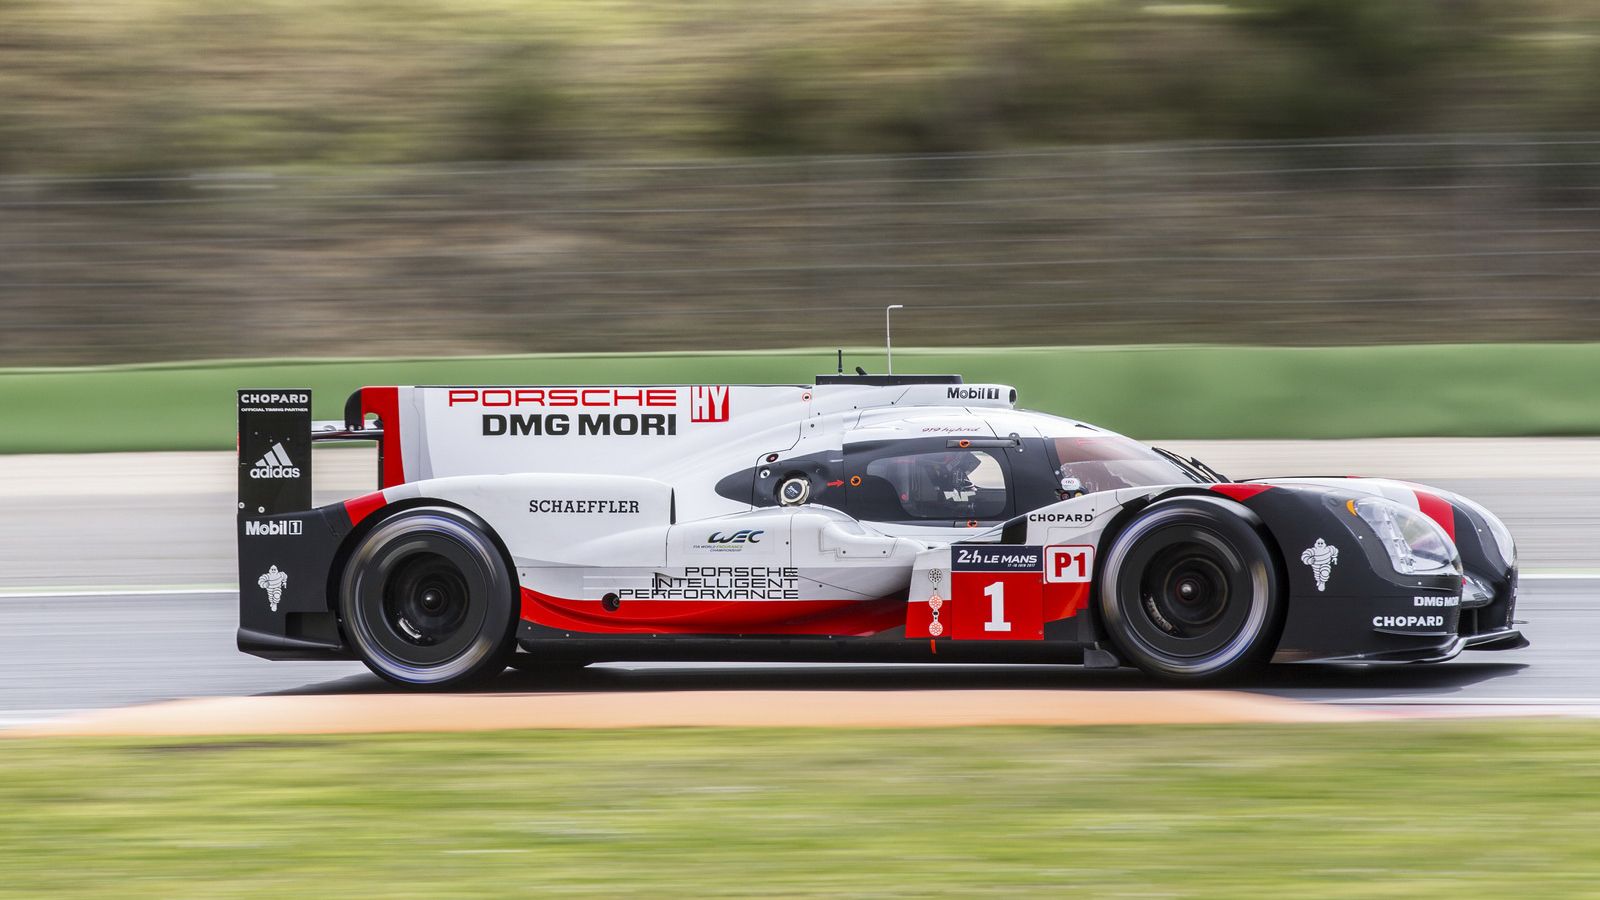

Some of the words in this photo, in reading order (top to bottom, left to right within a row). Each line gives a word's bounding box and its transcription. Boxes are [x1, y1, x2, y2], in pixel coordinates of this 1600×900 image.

[240, 393, 309, 404] CHOPARD
[449, 389, 677, 407] PORSCHE
[947, 387, 985, 400] Mobil
[691, 386, 729, 422] HY
[482, 413, 570, 436] DMG
[578, 413, 677, 436] MORI
[249, 465, 301, 479] adidas
[529, 499, 640, 514] SCHAEFFLER
[1029, 513, 1094, 523] CHOPARD
[245, 520, 288, 536] Mobil
[707, 529, 765, 544] WEC
[956, 550, 982, 564] 24h
[984, 555, 1000, 564] LE
[1000, 555, 1038, 564] MANS
[685, 567, 799, 577] PORSCHE
[1054, 552, 1086, 578] P1
[651, 577, 799, 589] INTELLIGENT
[618, 589, 799, 600] PERFORMANCE
[1413, 596, 1444, 607] DMG
[983, 581, 1012, 632] 1
[1372, 616, 1444, 627] CHOPARD
